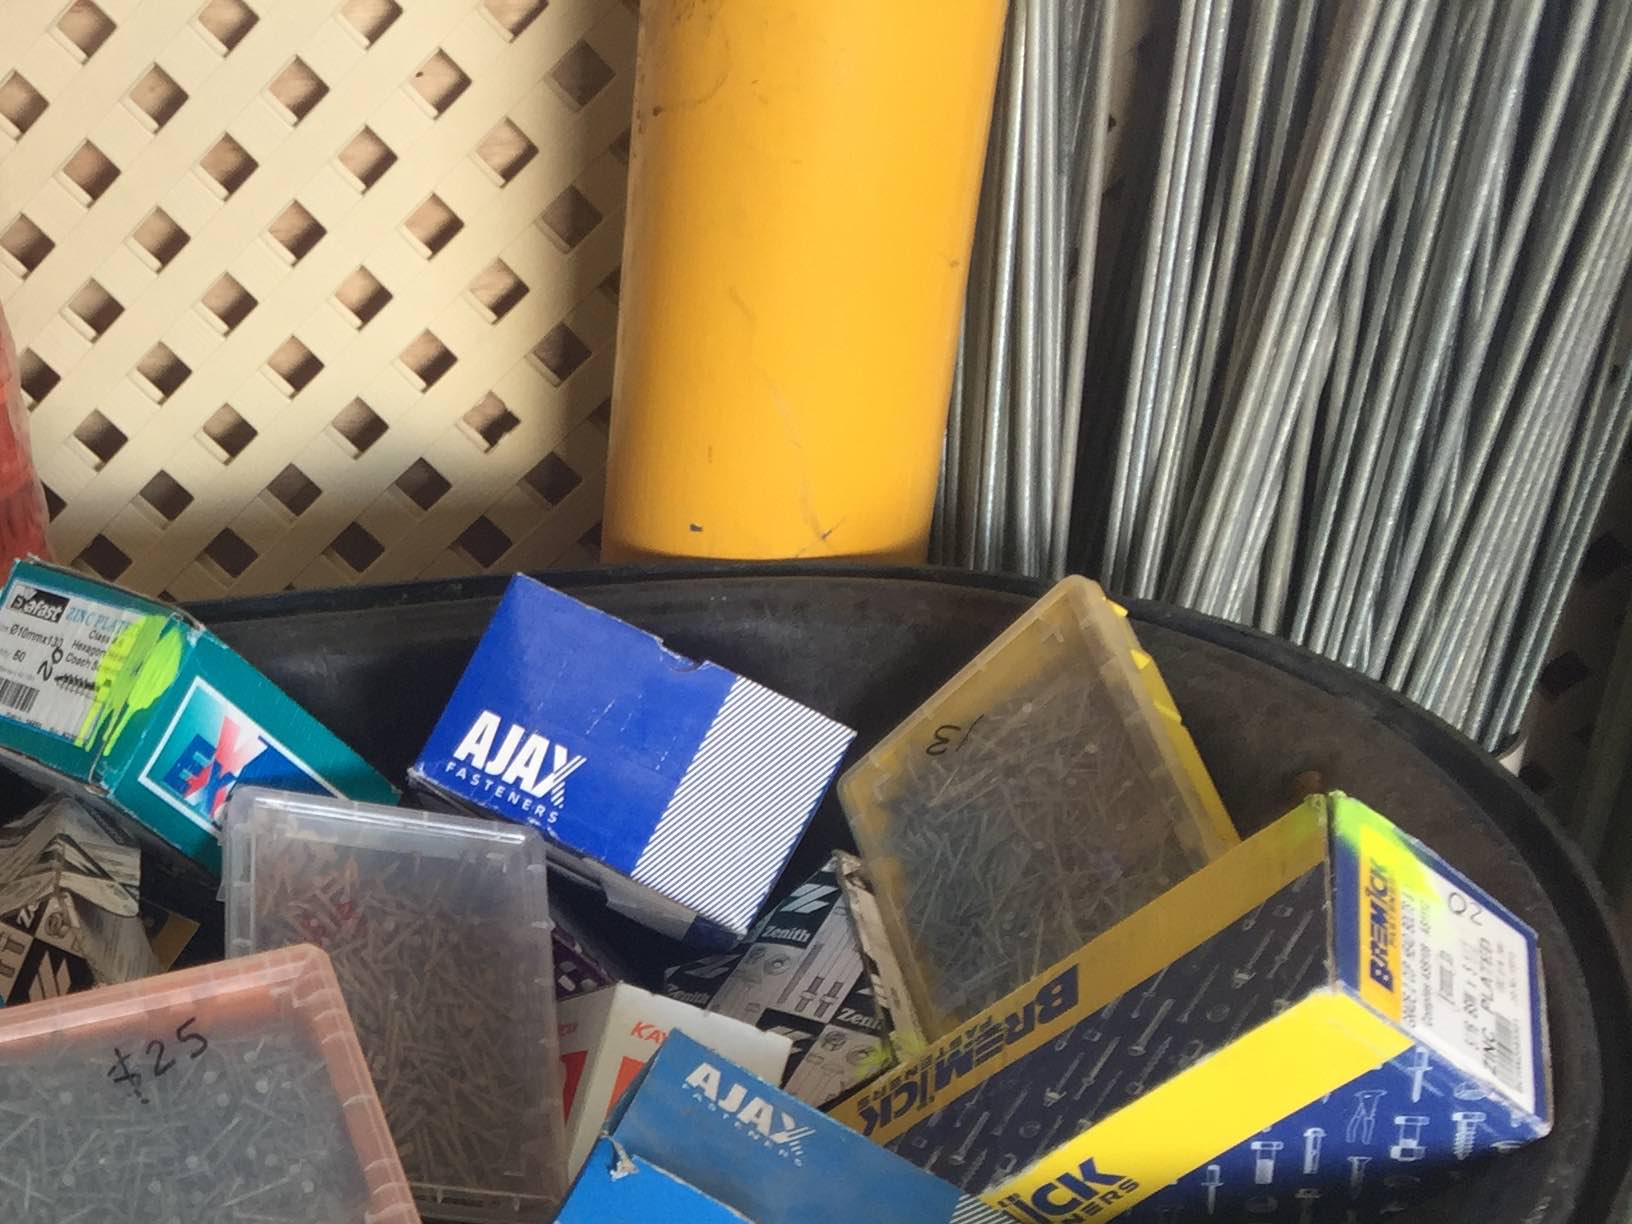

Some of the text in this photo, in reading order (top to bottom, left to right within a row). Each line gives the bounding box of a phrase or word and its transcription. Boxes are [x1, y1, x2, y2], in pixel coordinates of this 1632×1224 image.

[444, 761, 560, 825] FASTENERS
[452, 709, 588, 805] AJAX
[761, 924, 811, 944] Zenith
[858, 962, 1080, 1138] BREMICK
[684, 1061, 817, 1148] AJAX
